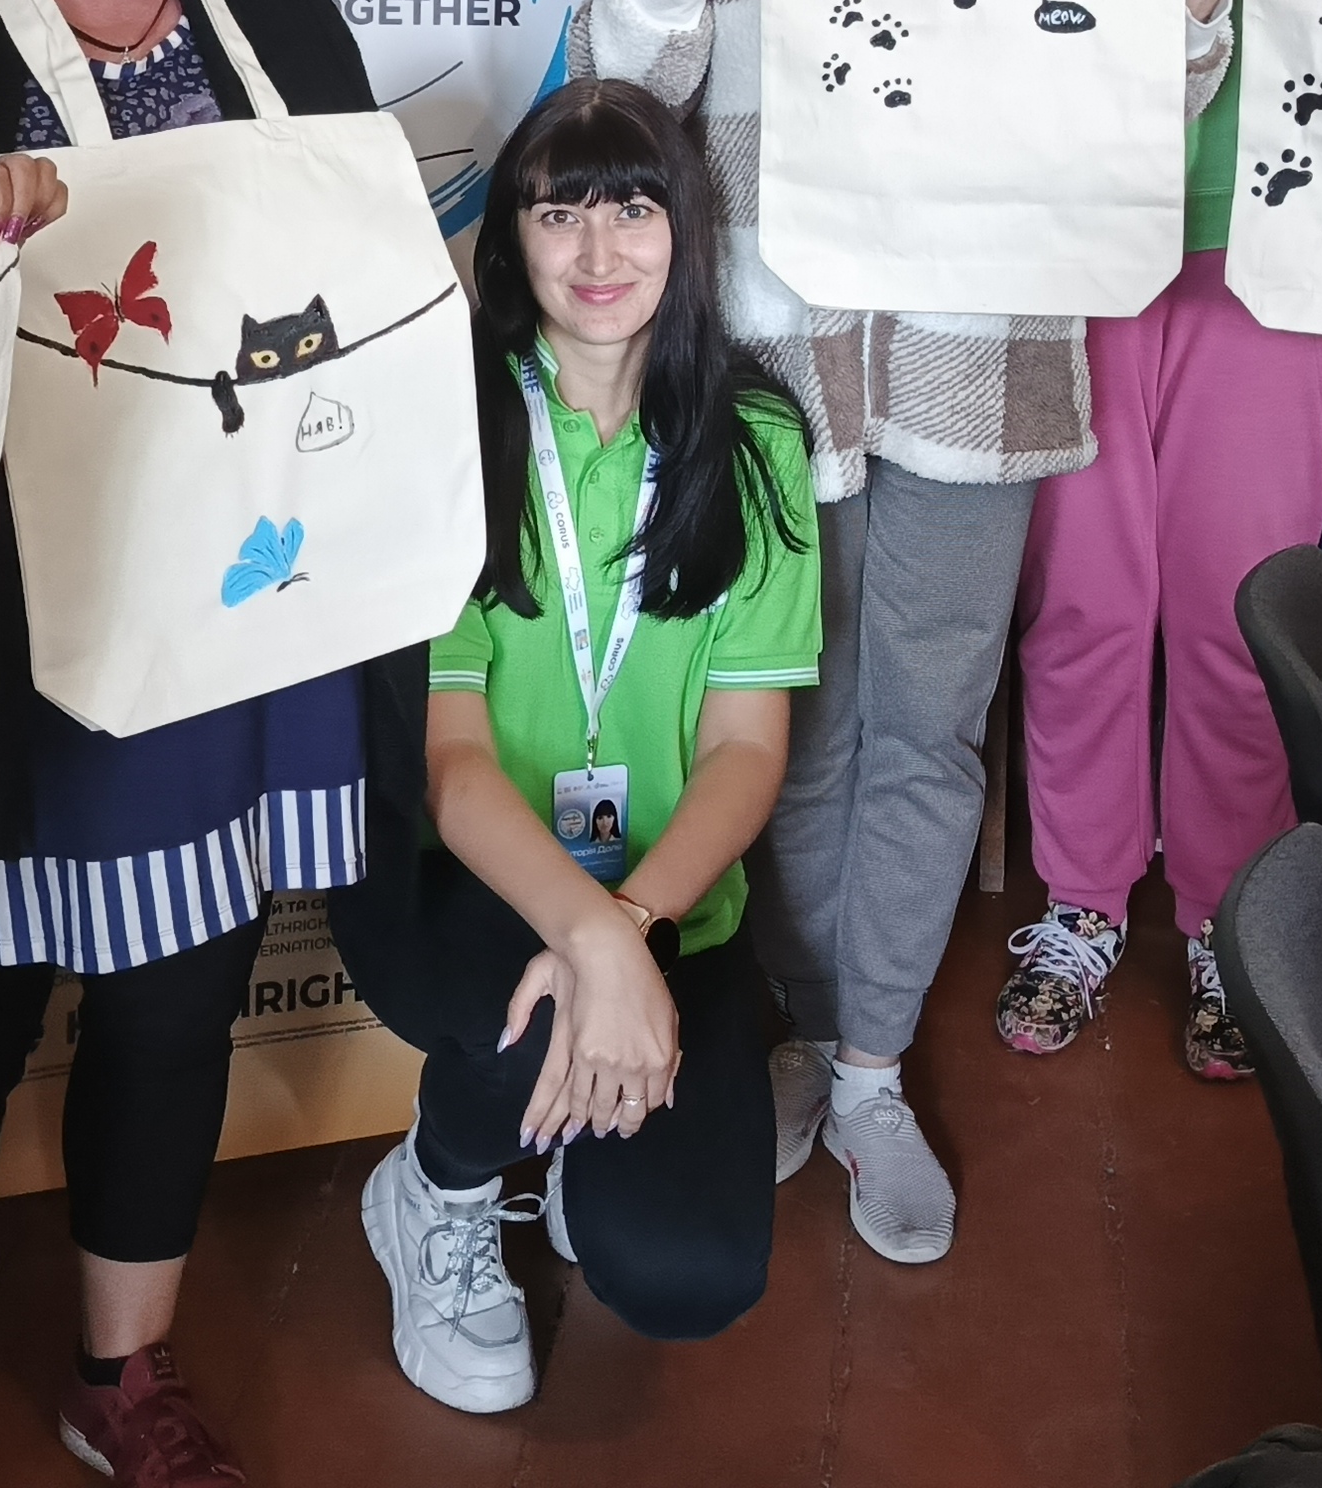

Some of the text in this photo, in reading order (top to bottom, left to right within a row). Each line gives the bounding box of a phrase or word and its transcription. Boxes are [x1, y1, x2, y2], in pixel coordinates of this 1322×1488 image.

[555, 511, 571, 550] CORUS
[607, 637, 625, 672] CORUS
[270, 898, 283, 916] Й
[265, 917, 330, 937] LTHRIGH
[260, 936, 339, 958] ERNATION
